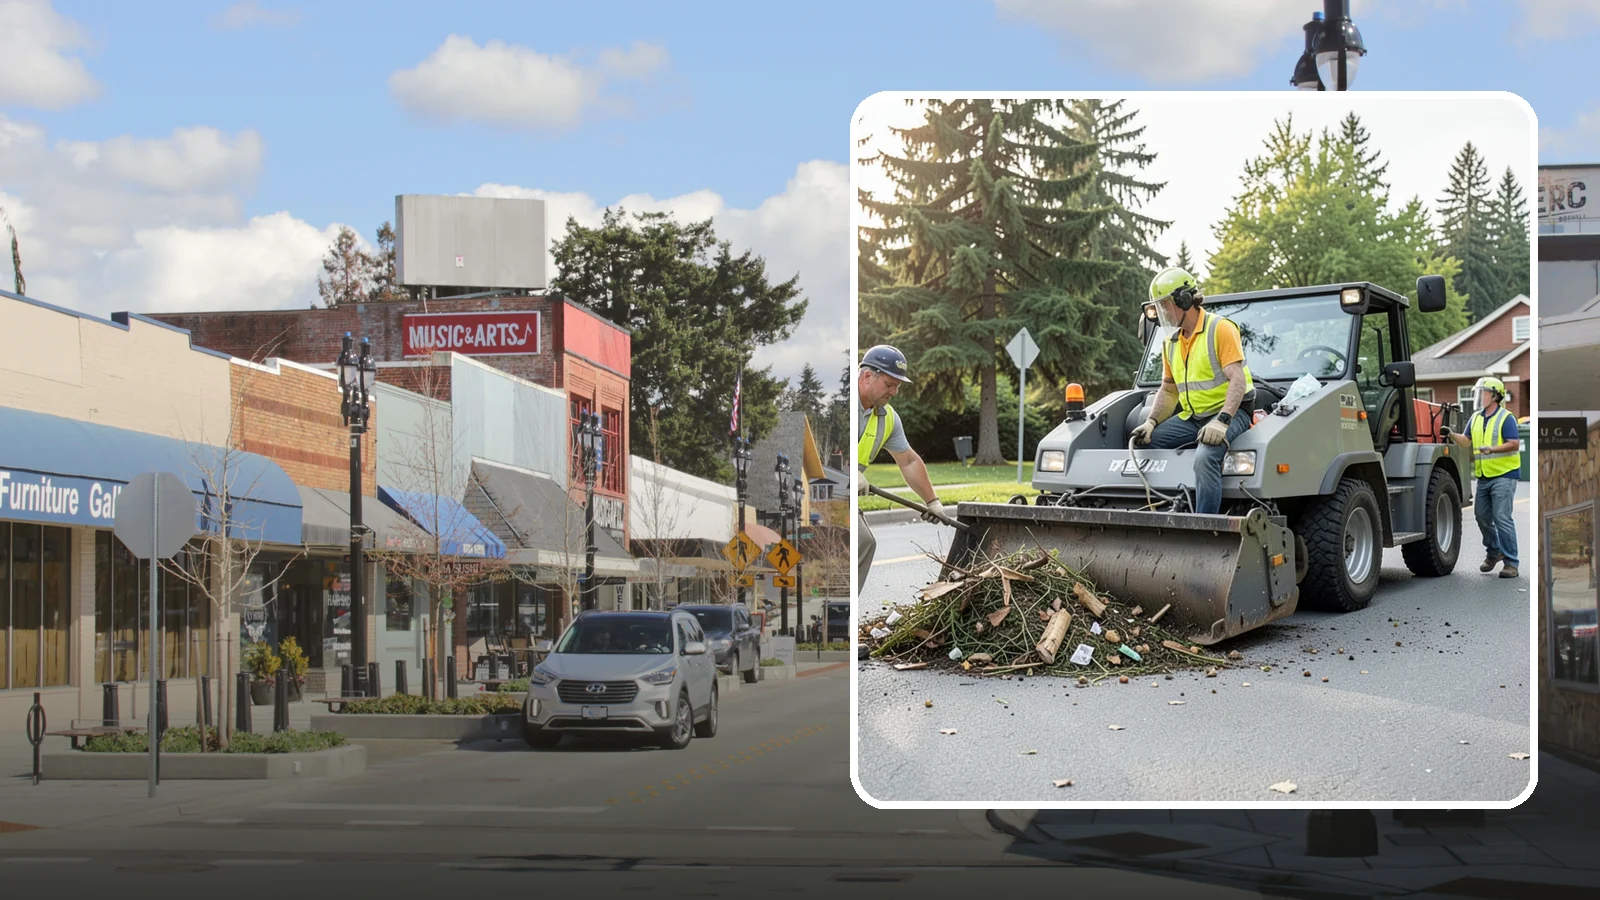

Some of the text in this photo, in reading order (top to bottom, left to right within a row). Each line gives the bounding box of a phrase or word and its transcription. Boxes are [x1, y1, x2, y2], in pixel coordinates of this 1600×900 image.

[0, 471, 122, 519] Furniture Gal
[453, 563, 480, 574] SUSHI
